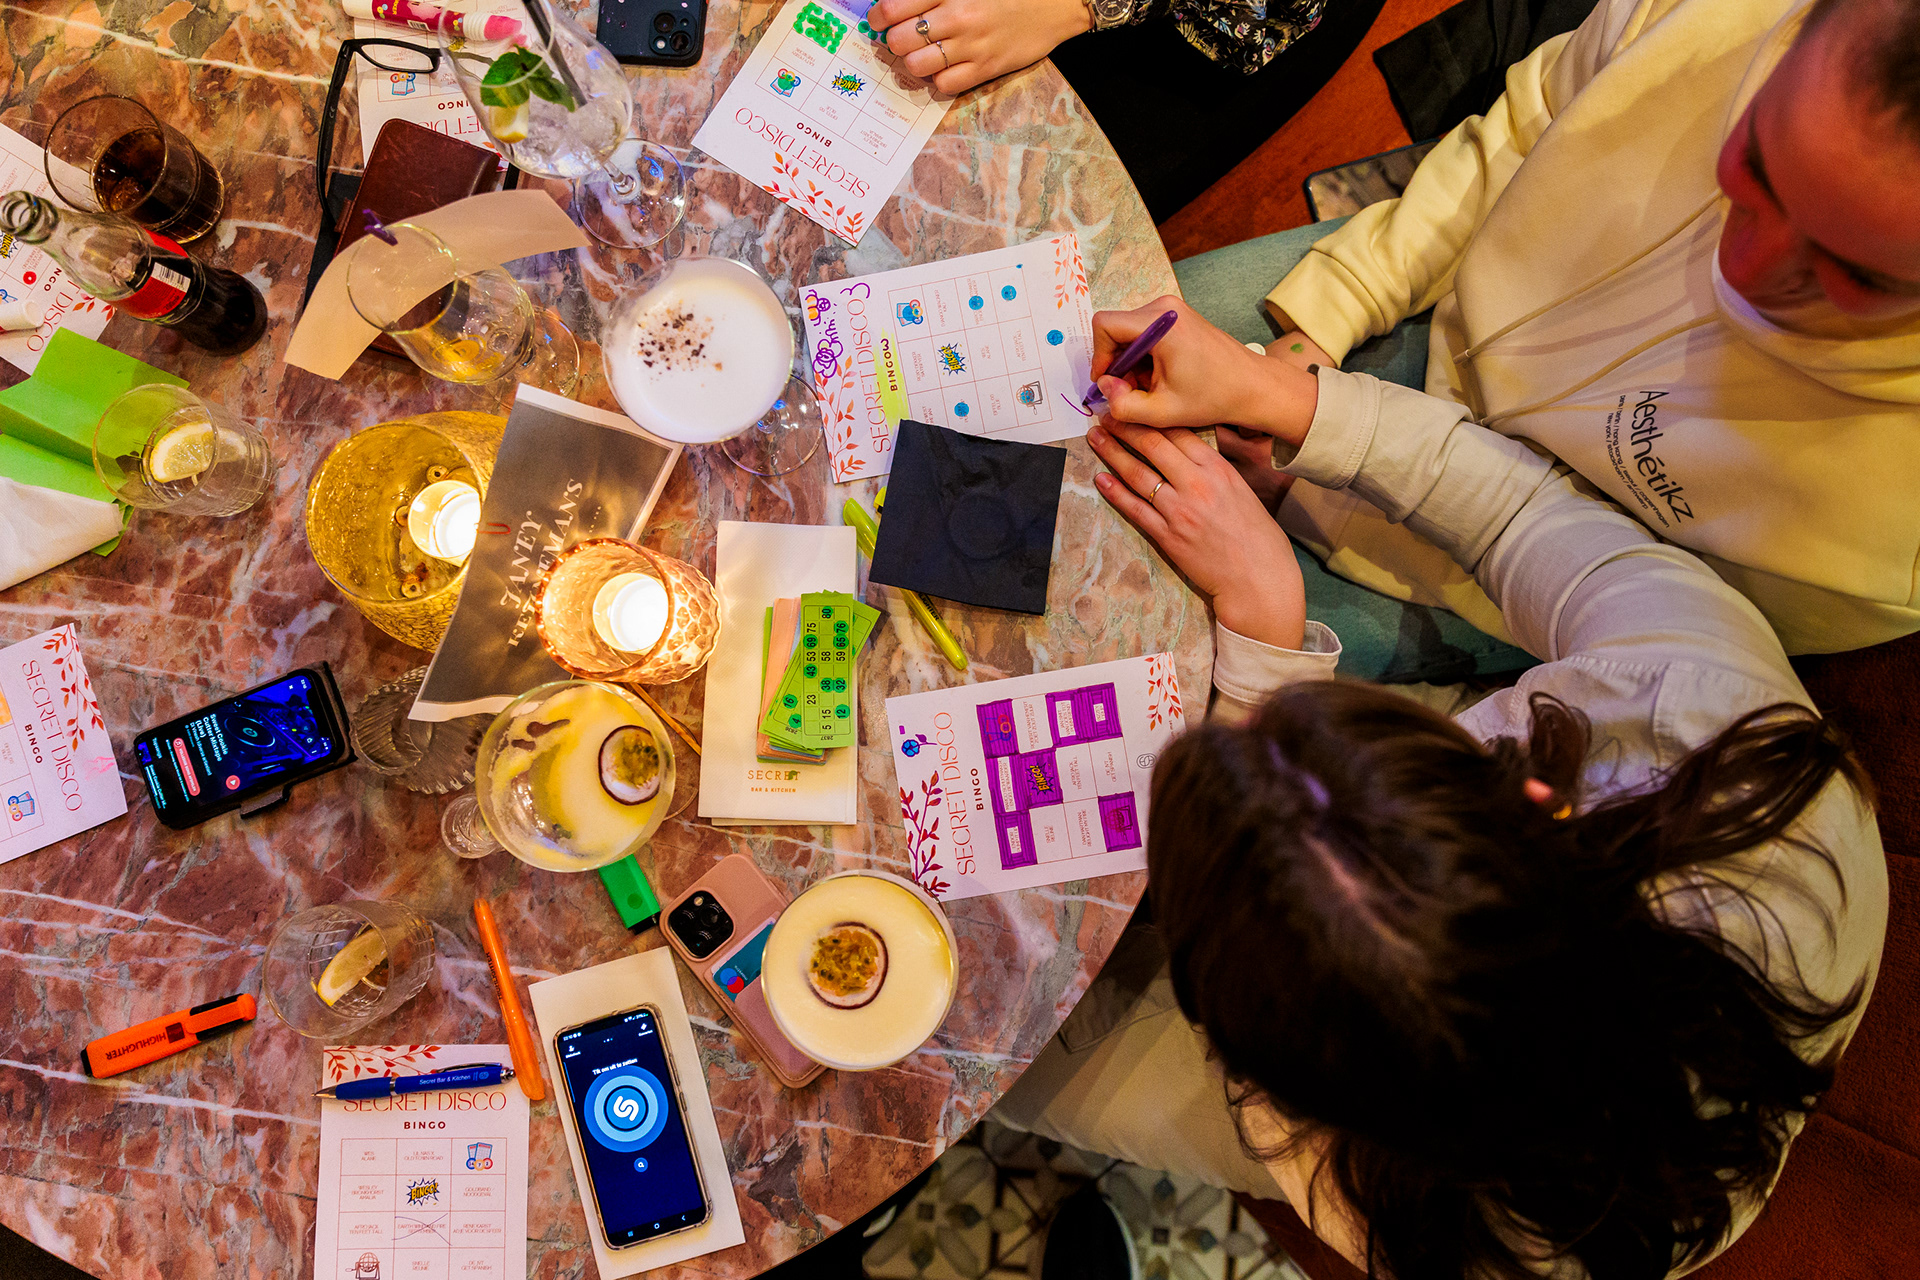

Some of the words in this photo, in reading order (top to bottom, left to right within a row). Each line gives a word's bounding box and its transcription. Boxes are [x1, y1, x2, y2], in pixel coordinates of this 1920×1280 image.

[438, 101, 468, 110] INGO
[736, 108, 795, 152] DISCO
[797, 123, 831, 147] BINGO
[792, 146, 870, 197] SECRET
[44, 268, 62, 291] NGO
[847, 299, 876, 364] DISCO
[860, 367, 892, 453] SECRET
[1630, 391, 1694, 523] Aesthétikz
[1607, 444, 1625, 480] stockholm
[1627, 484, 1648, 510] antwerp
[1639, 490, 1670, 528] copenhagen
[499, 510, 542, 608] JANEY
[821, 608, 832, 619] 80
[806, 622, 817, 633] 75
[836, 623, 846, 634] 76
[806, 637, 816, 648] 69
[836, 637, 846, 648] 65
[806, 651, 816, 662] 53
[821, 651, 831, 662] 58
[835, 651, 846, 662] 59
[806, 665, 816, 677] 43
[821, 679, 831, 691] 38
[835, 679, 846, 691] 32
[784, 697, 795, 708] 16
[807, 694, 816, 705] 23
[821, 709, 832, 719] 15
[836, 709, 847, 719] 12
[22, 660, 64, 739] SECRET
[52, 745, 82, 811] DISCO
[195, 719, 207, 738] (Live)
[202, 716, 215, 737] Cutter
[209, 714, 221, 734] Sweet
[216, 733, 229, 755] Cookie
[25, 724, 42, 763] BINGO
[208, 736, 223, 762] Mixtape
[935, 712, 960, 781] DISCO
[747, 770, 801, 781] SECRET
[971, 769, 983, 810] BINGO
[945, 788, 975, 875] SECRET
[106, 1033, 166, 1060] HIGHLIGHTER
[451, 1074, 471, 1082] Kitchen
[344, 1092, 432, 1113] SECRET
[439, 1091, 506, 1110] DISCO
